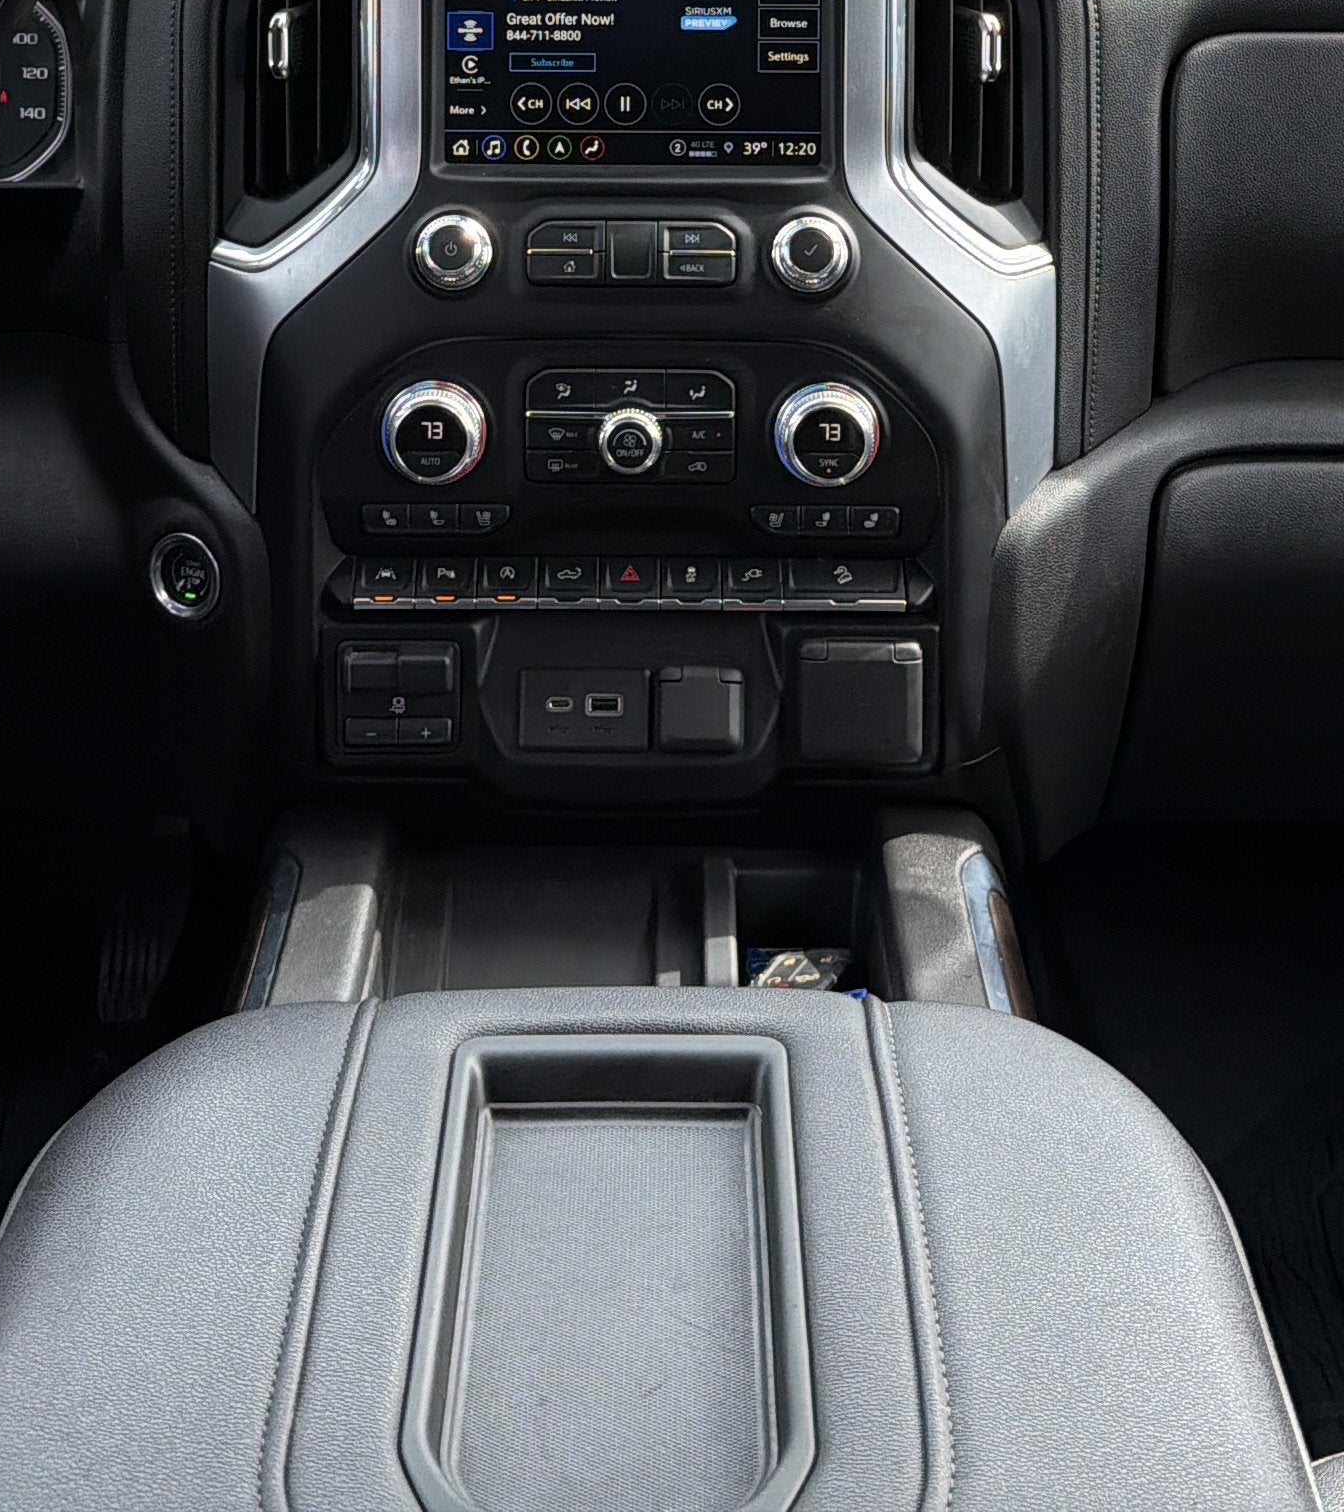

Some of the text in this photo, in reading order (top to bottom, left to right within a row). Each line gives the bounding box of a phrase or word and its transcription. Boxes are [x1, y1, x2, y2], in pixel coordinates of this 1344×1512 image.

[684, 6, 732, 16] SIRIUSXM
[506, 13, 615, 26] Great Offer Now!
[769, 18, 808, 29] Browse
[506, 30, 582, 42] 844-711-8800
[531, 58, 574, 67] Subscribe
[767, 50, 810, 64] Settings
[21, 67, 49, 80] 120
[449, 76, 477, 85] Ethan's
[527, 98, 544, 110] CH
[707, 99, 723, 111] CH
[19, 107, 46, 120] 140
[449, 105, 475, 116] More
[702, 141, 715, 149] LTE
[778, 142, 817, 155] 12:20
[686, 264, 705, 272] BACK
[421, 422, 443, 439] 73
[692, 431, 706, 439] A/C
[819, 424, 840, 441] 73
[616, 449, 645, 457] ON/OFF
[421, 457, 441, 466] AUTO
[819, 458, 839, 467] SYNC
